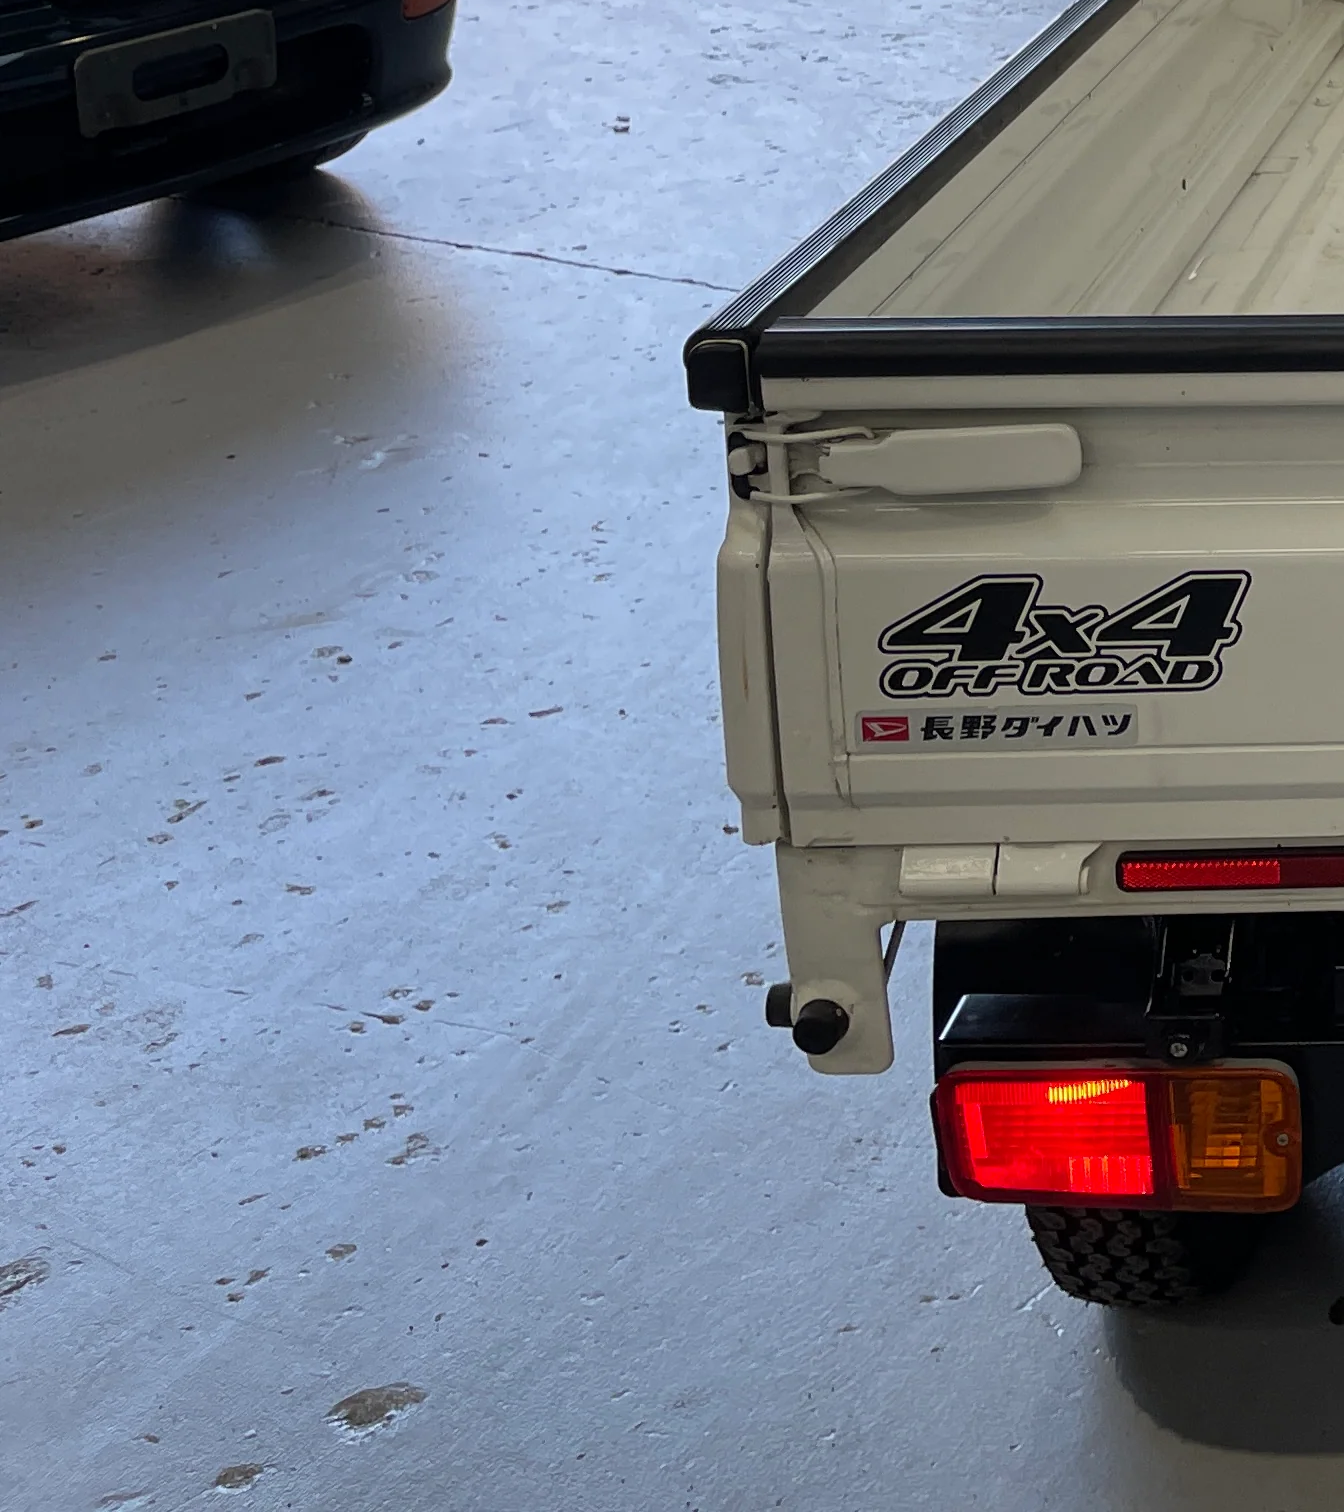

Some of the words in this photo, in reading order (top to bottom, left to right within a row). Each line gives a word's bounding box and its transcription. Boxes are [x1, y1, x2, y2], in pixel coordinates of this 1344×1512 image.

[884, 661, 1023, 693] OFF
[1023, 656, 1216, 692] ROAD
[921, 713, 1132, 741] 長野ダイハツ
